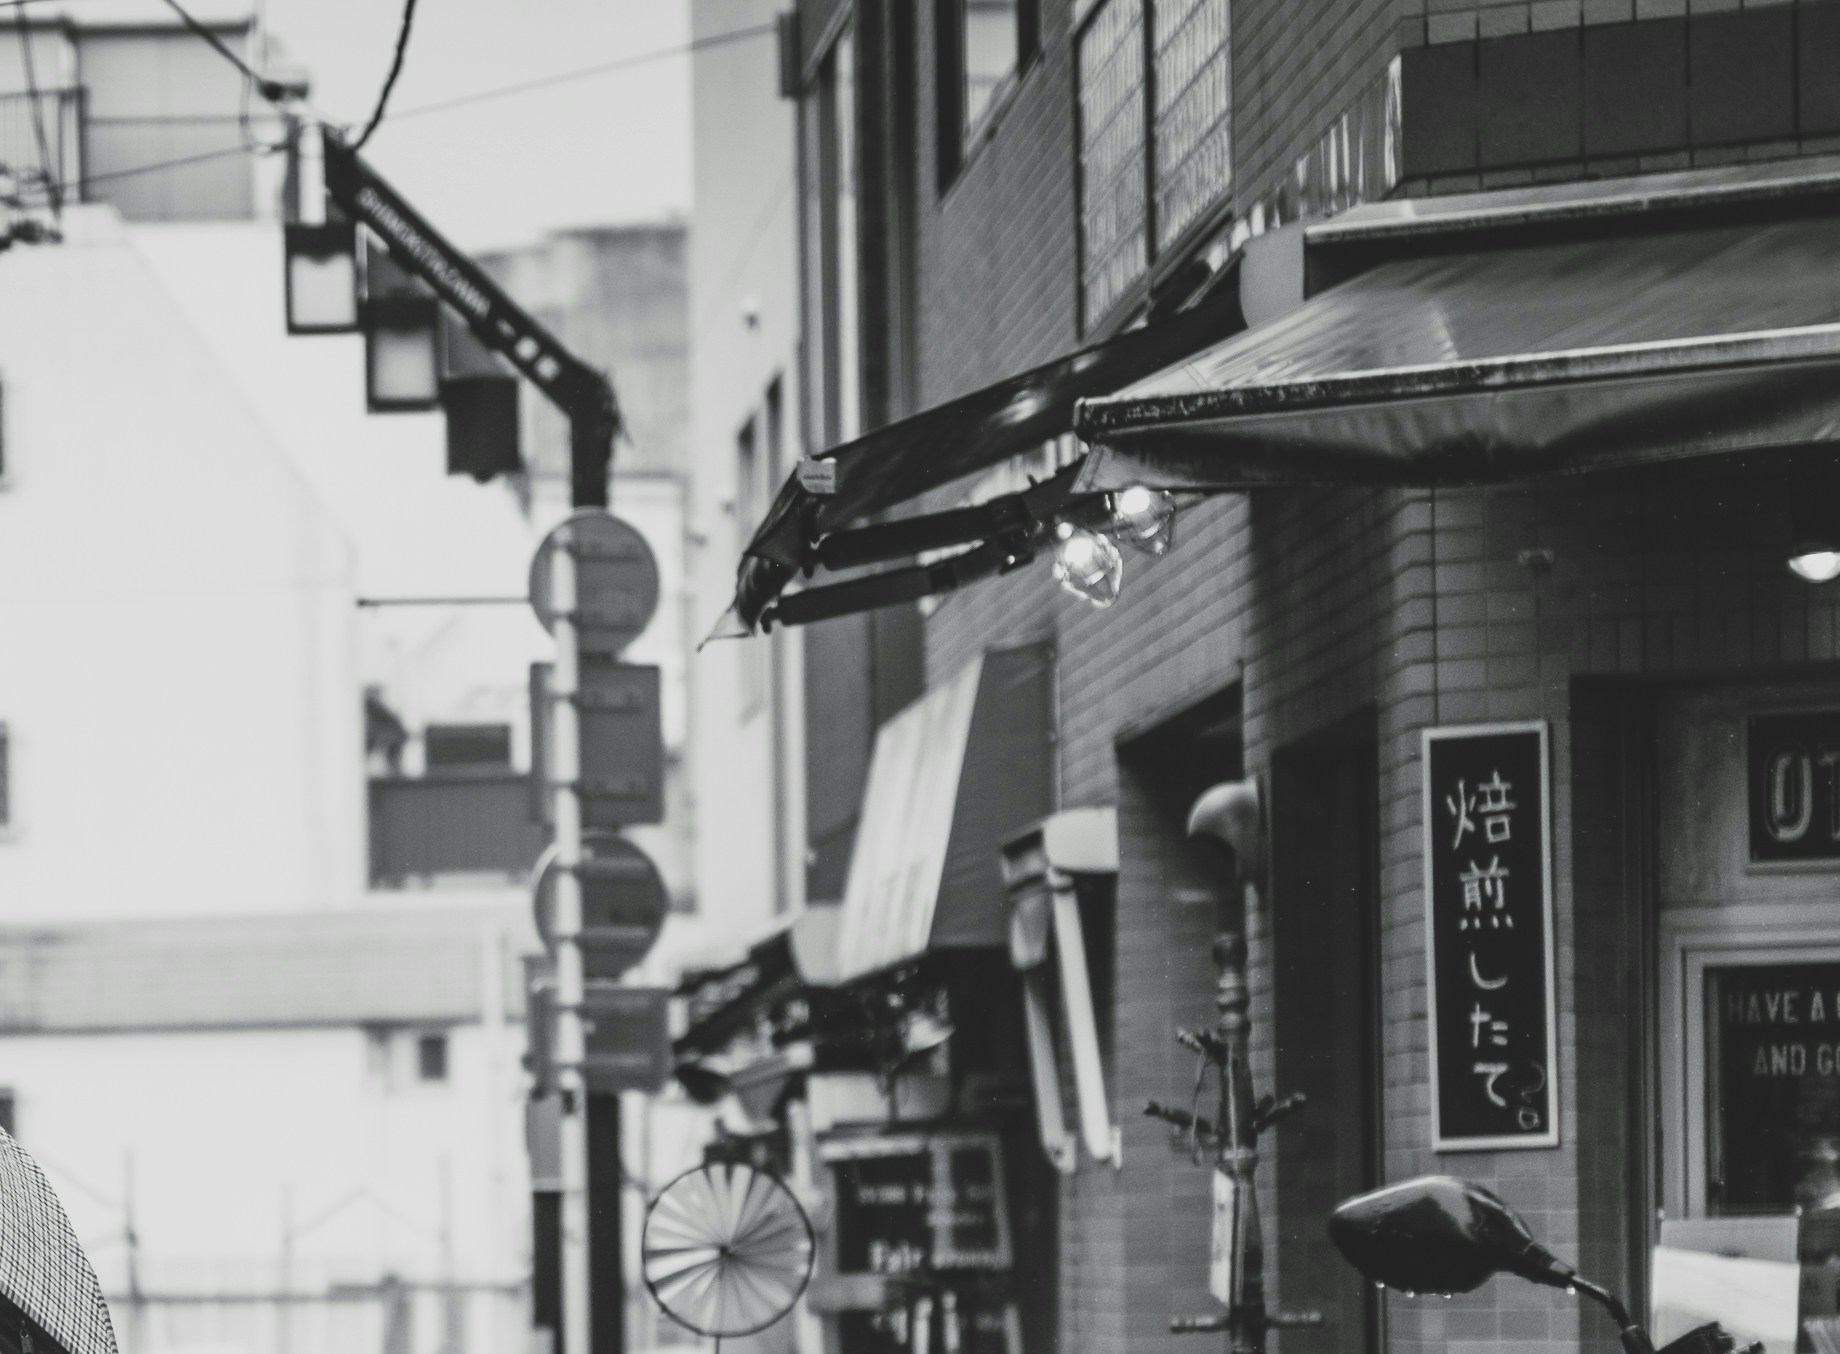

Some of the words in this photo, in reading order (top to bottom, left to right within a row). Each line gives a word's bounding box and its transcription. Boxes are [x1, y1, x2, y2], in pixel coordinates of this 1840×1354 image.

[1445, 769, 1519, 1107] 焙煎したて
[1728, 991, 1800, 1024] HAVE
[1810, 991, 1827, 1023] A
[1753, 1044, 1807, 1077] AND
